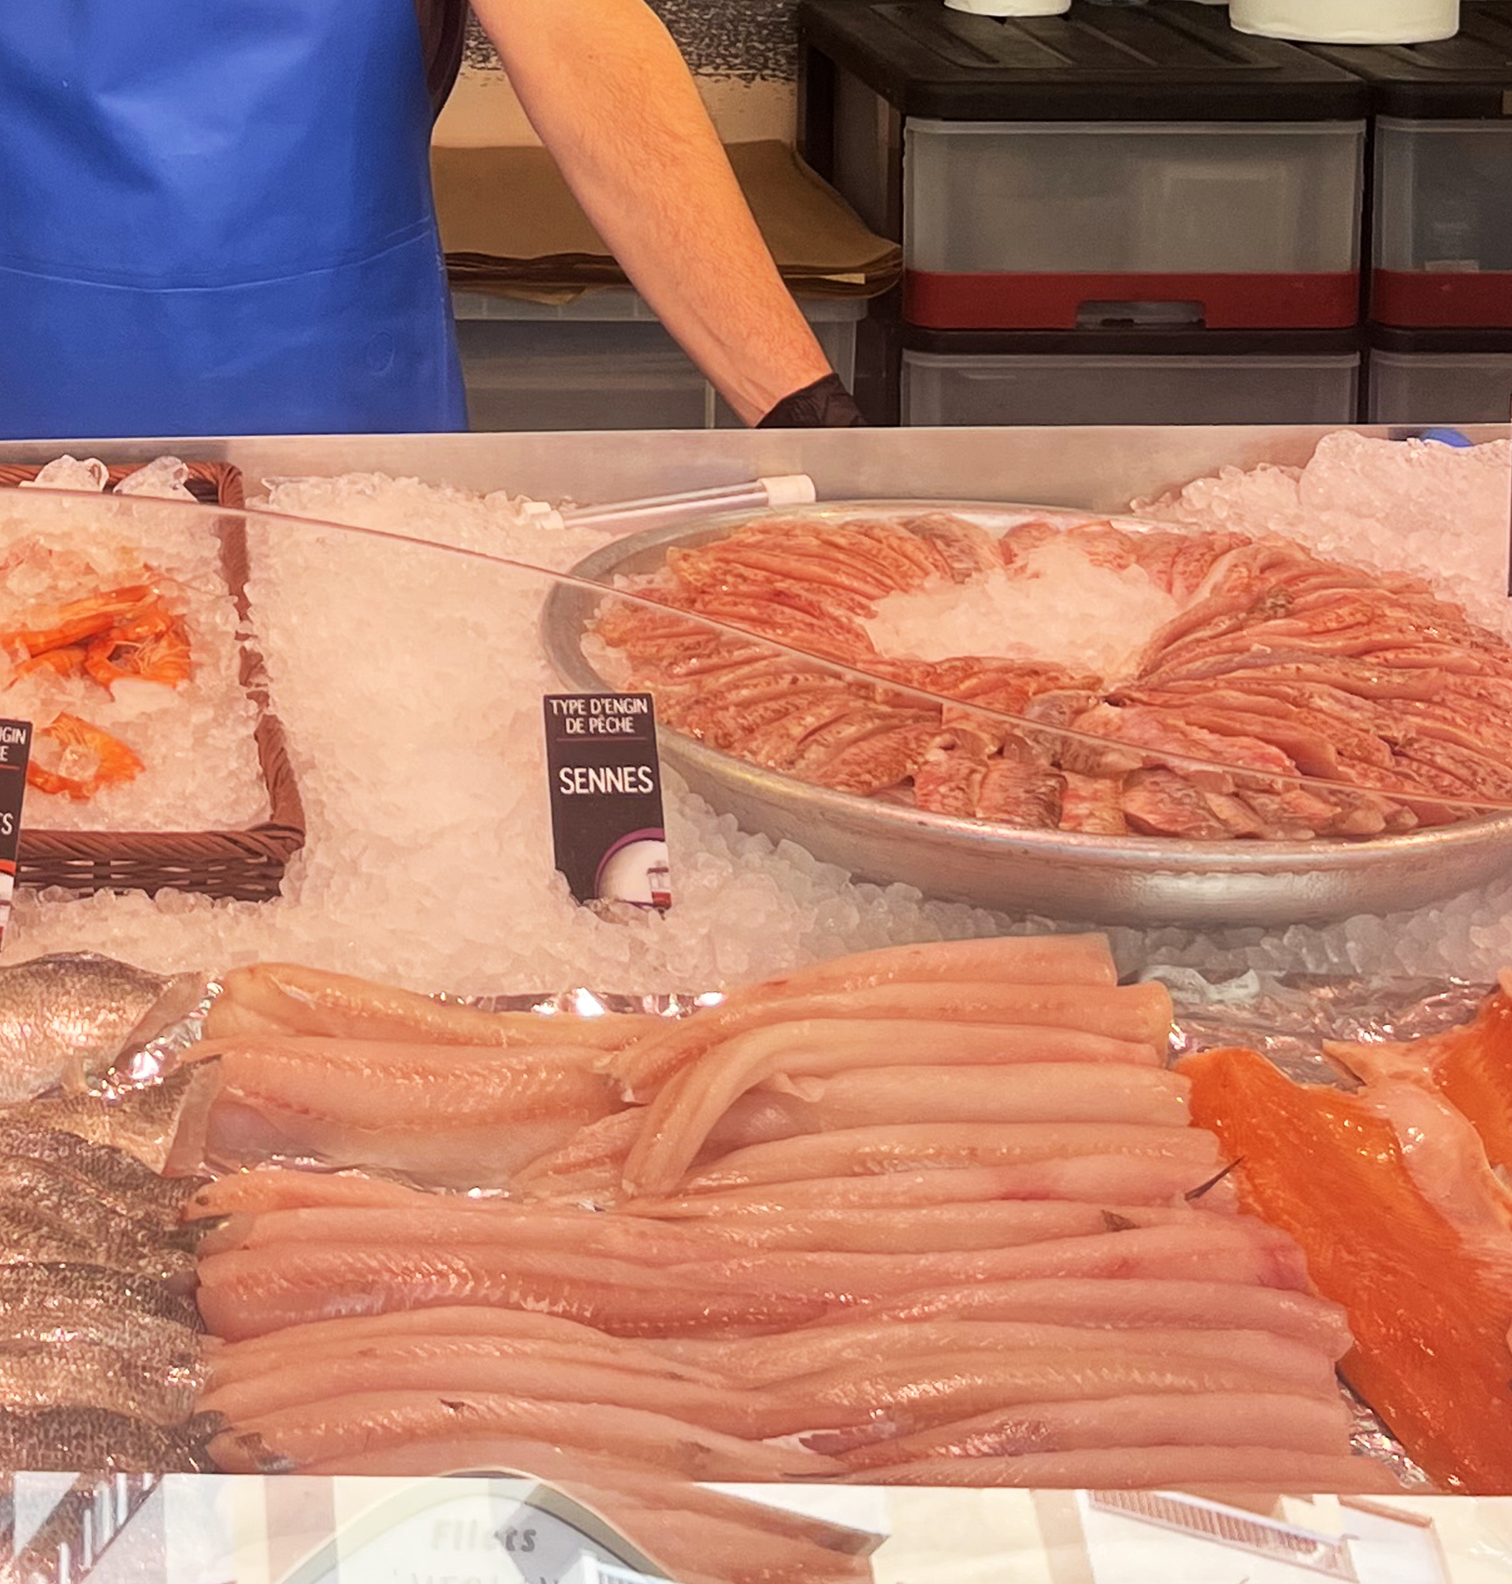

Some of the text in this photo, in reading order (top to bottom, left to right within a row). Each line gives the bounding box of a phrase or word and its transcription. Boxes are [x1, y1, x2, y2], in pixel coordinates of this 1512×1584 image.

[549, 697, 648, 715] TYPE D'ENGIN
[565, 714, 636, 734] DE PÊCHE
[558, 765, 655, 795] SENNES
